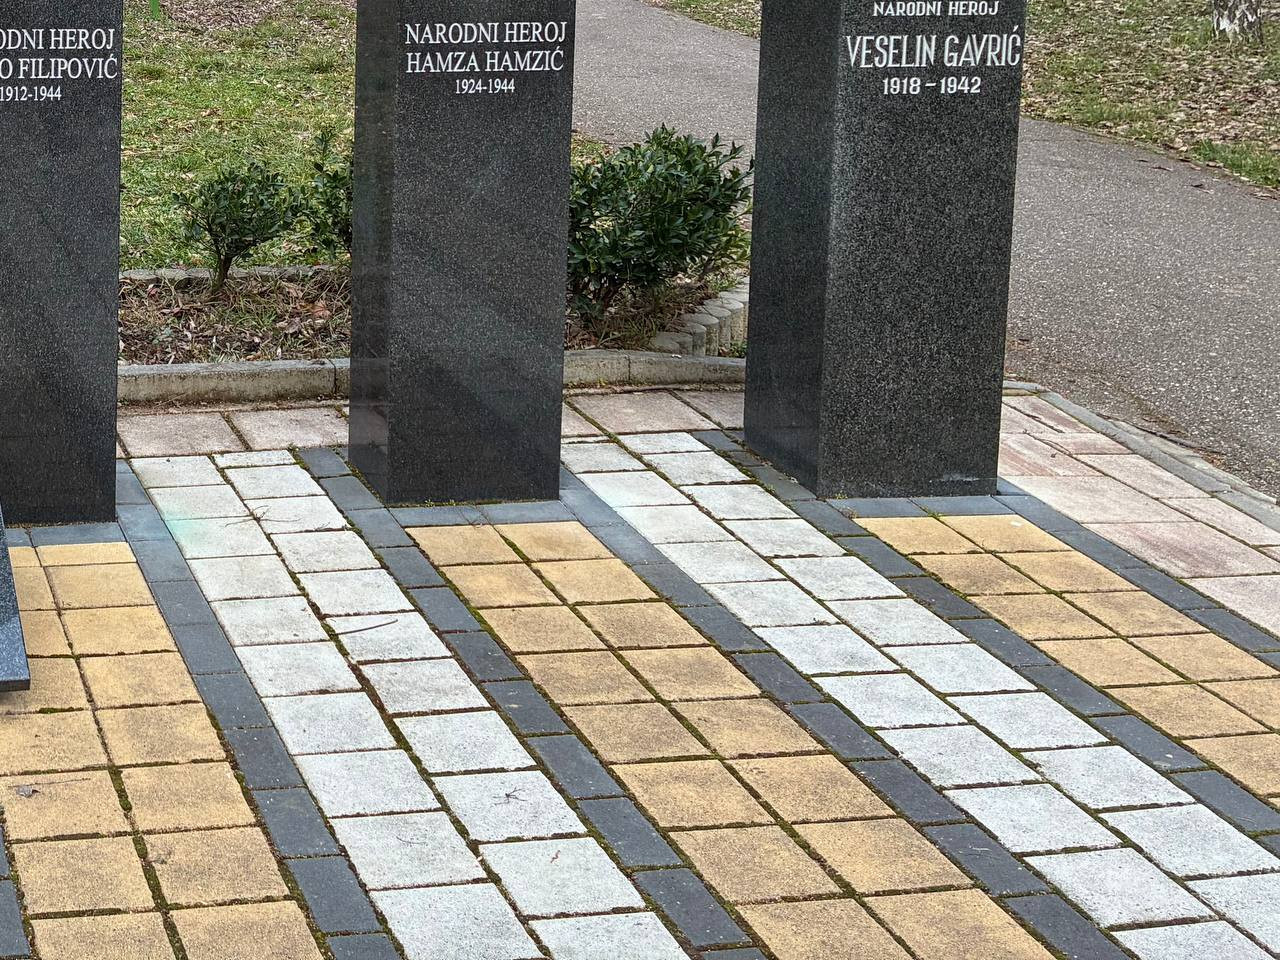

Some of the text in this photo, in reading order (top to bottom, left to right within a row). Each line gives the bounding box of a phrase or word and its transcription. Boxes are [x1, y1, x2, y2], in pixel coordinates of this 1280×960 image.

[873, 0, 999, 17] NARODNI HEROJ
[49, 28, 115, 50] HEROJ
[404, 21, 567, 44] NARODNI HEROJ
[846, 25, 1021, 68] VESELIN GAVRIĆ
[18, 54, 118, 79] FILIPOVIĆ
[406, 46, 564, 73] HAMZA HAMZIĆ
[0, 86, 62, 102] 1912-1944
[455, 78, 515, 94] 1924-1944
[882, 76, 921, 95] 1918
[940, 76, 981, 94] 1942
